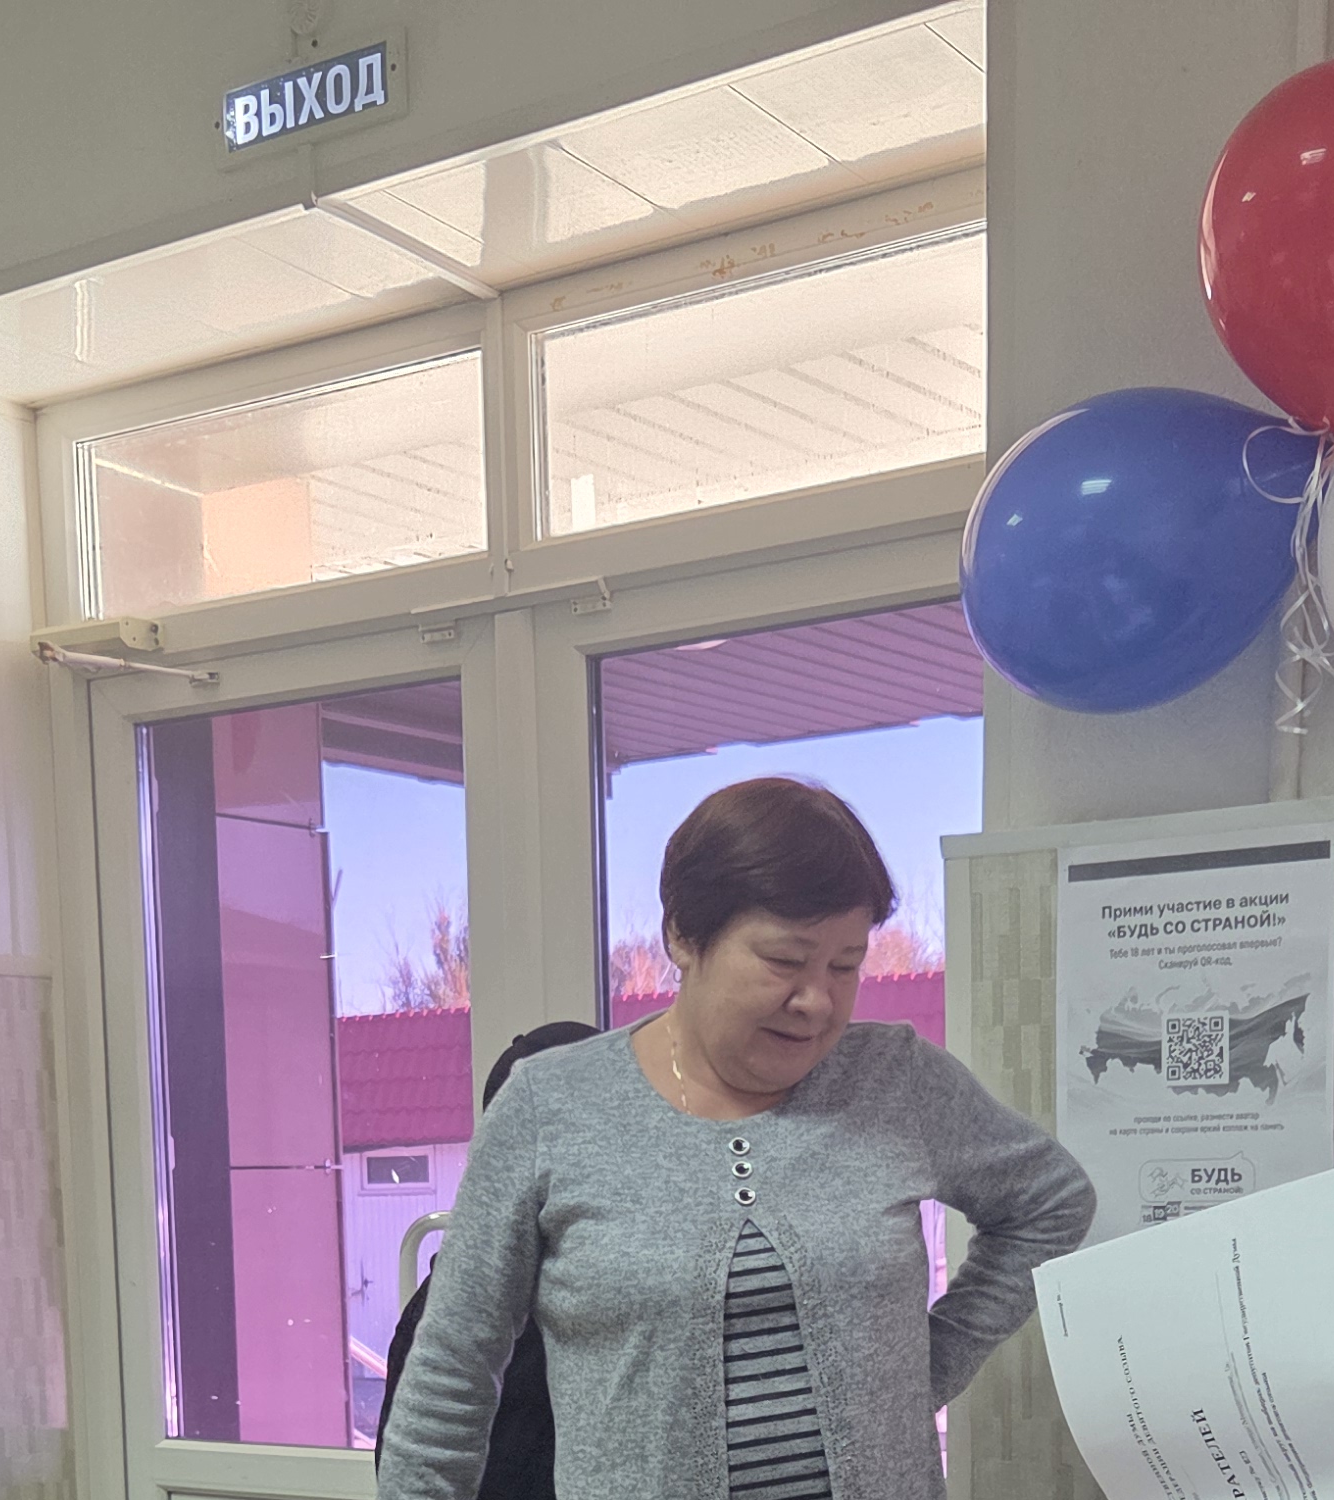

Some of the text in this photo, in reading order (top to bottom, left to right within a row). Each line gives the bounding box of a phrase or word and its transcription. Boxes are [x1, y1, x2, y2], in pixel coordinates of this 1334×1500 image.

[234, 53, 385, 145] ВЫХОД
[1101, 893, 1290, 921] Прими участие в акции
[1107, 909, 1287, 940] «БУДЬ СО СТРАНОЙ!»
[1191, 1167, 1243, 1186] БУДЬ
[1154, 1208, 1165, 1218] 19
[1167, 1204, 1179, 1213] 20
[1117, 1335, 1133, 1384] СОЗЫВА
[1126, 1413, 1146, 1446] ДУМЫ
[1129, 1387, 1156, 1445] ДЕВЯТОГО
